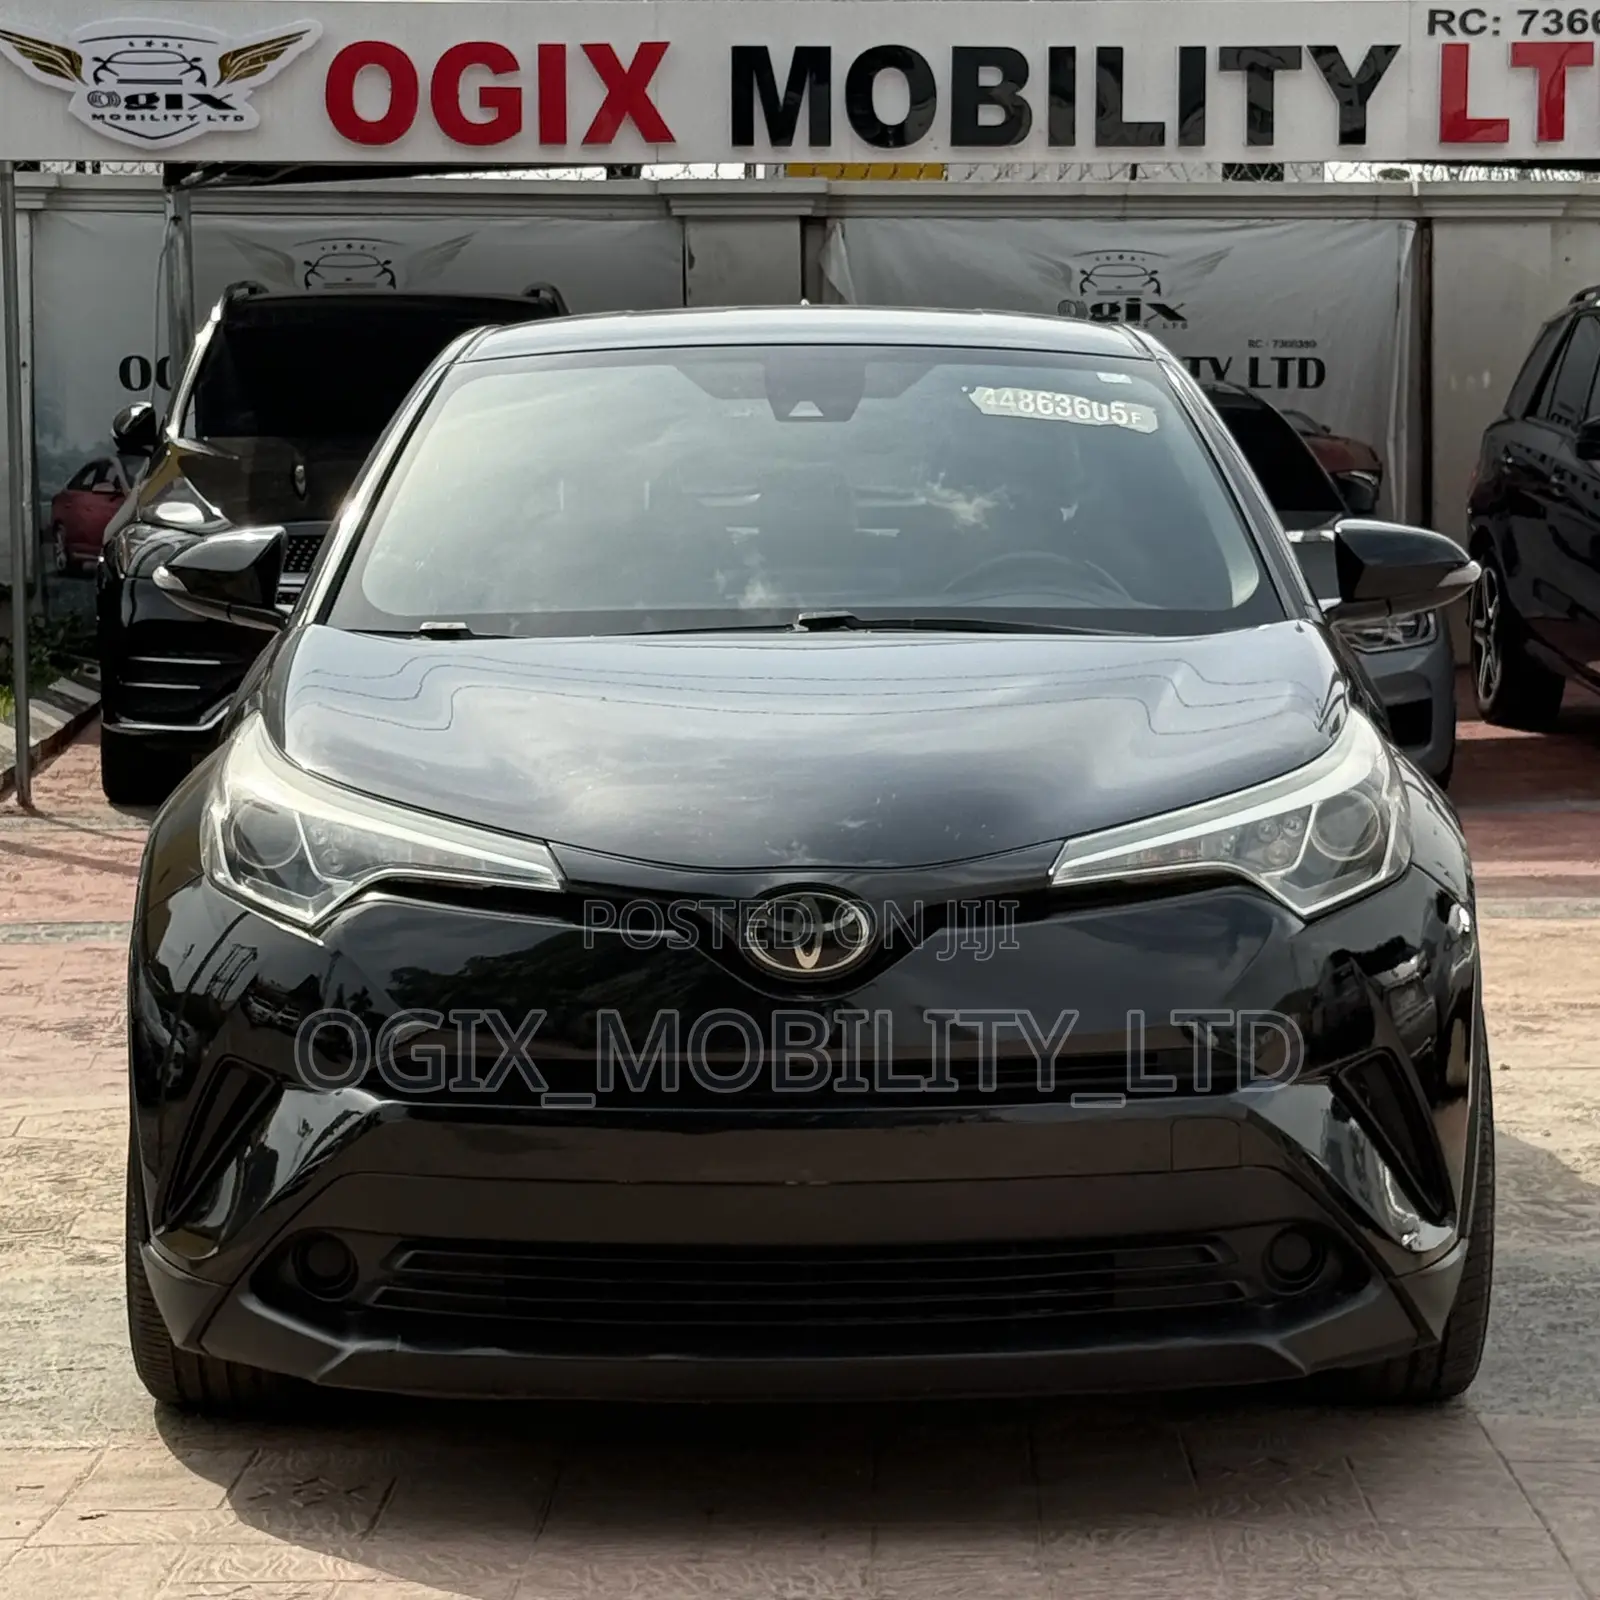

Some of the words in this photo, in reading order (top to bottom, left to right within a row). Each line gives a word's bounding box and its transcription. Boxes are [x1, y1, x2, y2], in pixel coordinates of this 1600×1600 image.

[1427, 8, 1500, 36] RC:
[325, 40, 676, 146] OGIX
[731, 44, 1401, 149] MOBILITY
[91, 113, 198, 121] MOBILITY
[206, 114, 245, 122] LTD
[1248, 356, 1326, 389] LTD
